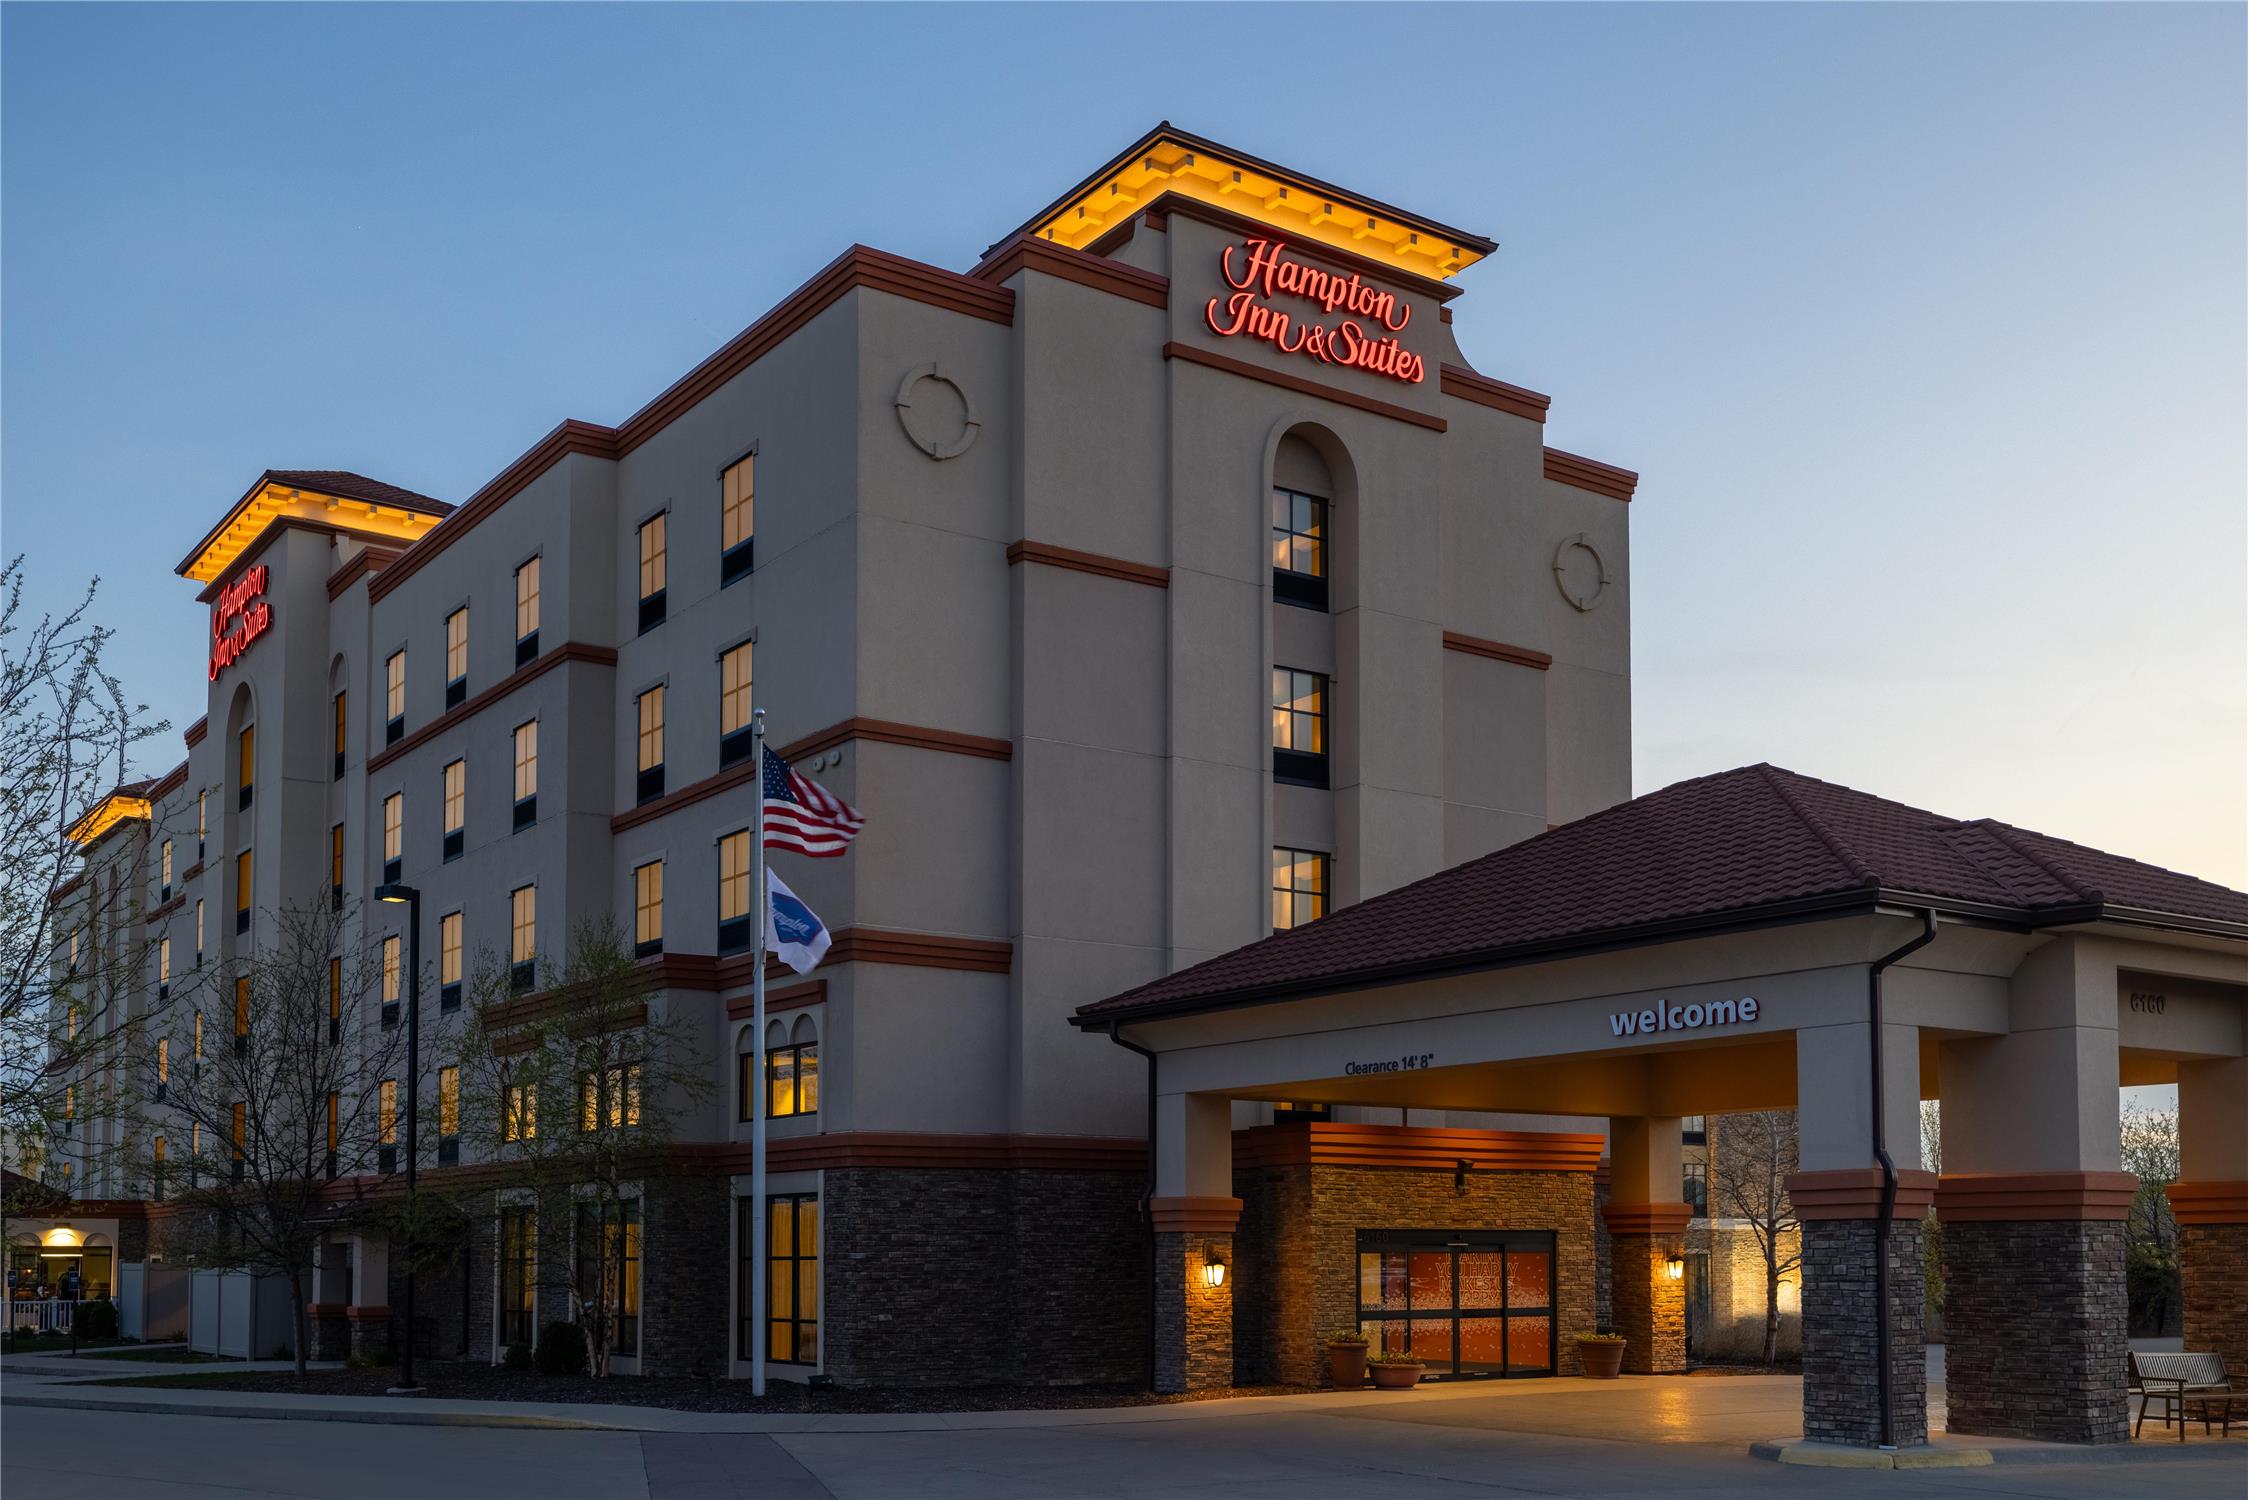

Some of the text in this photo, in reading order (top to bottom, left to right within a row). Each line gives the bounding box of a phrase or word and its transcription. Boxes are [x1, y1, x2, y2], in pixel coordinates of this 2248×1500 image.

[1221, 239, 1411, 332] Hampton
[1204, 292, 1424, 383] Inn & Suites
[213, 565, 266, 639] Hampton
[239, 603, 269, 650] Suites
[1609, 997, 1759, 1036] welcome
[2130, 992, 2165, 1015] 6160
[1345, 1053, 1434, 1076] Clearance 14' 8"
[1469, 1262, 1519, 1277] HAPY
